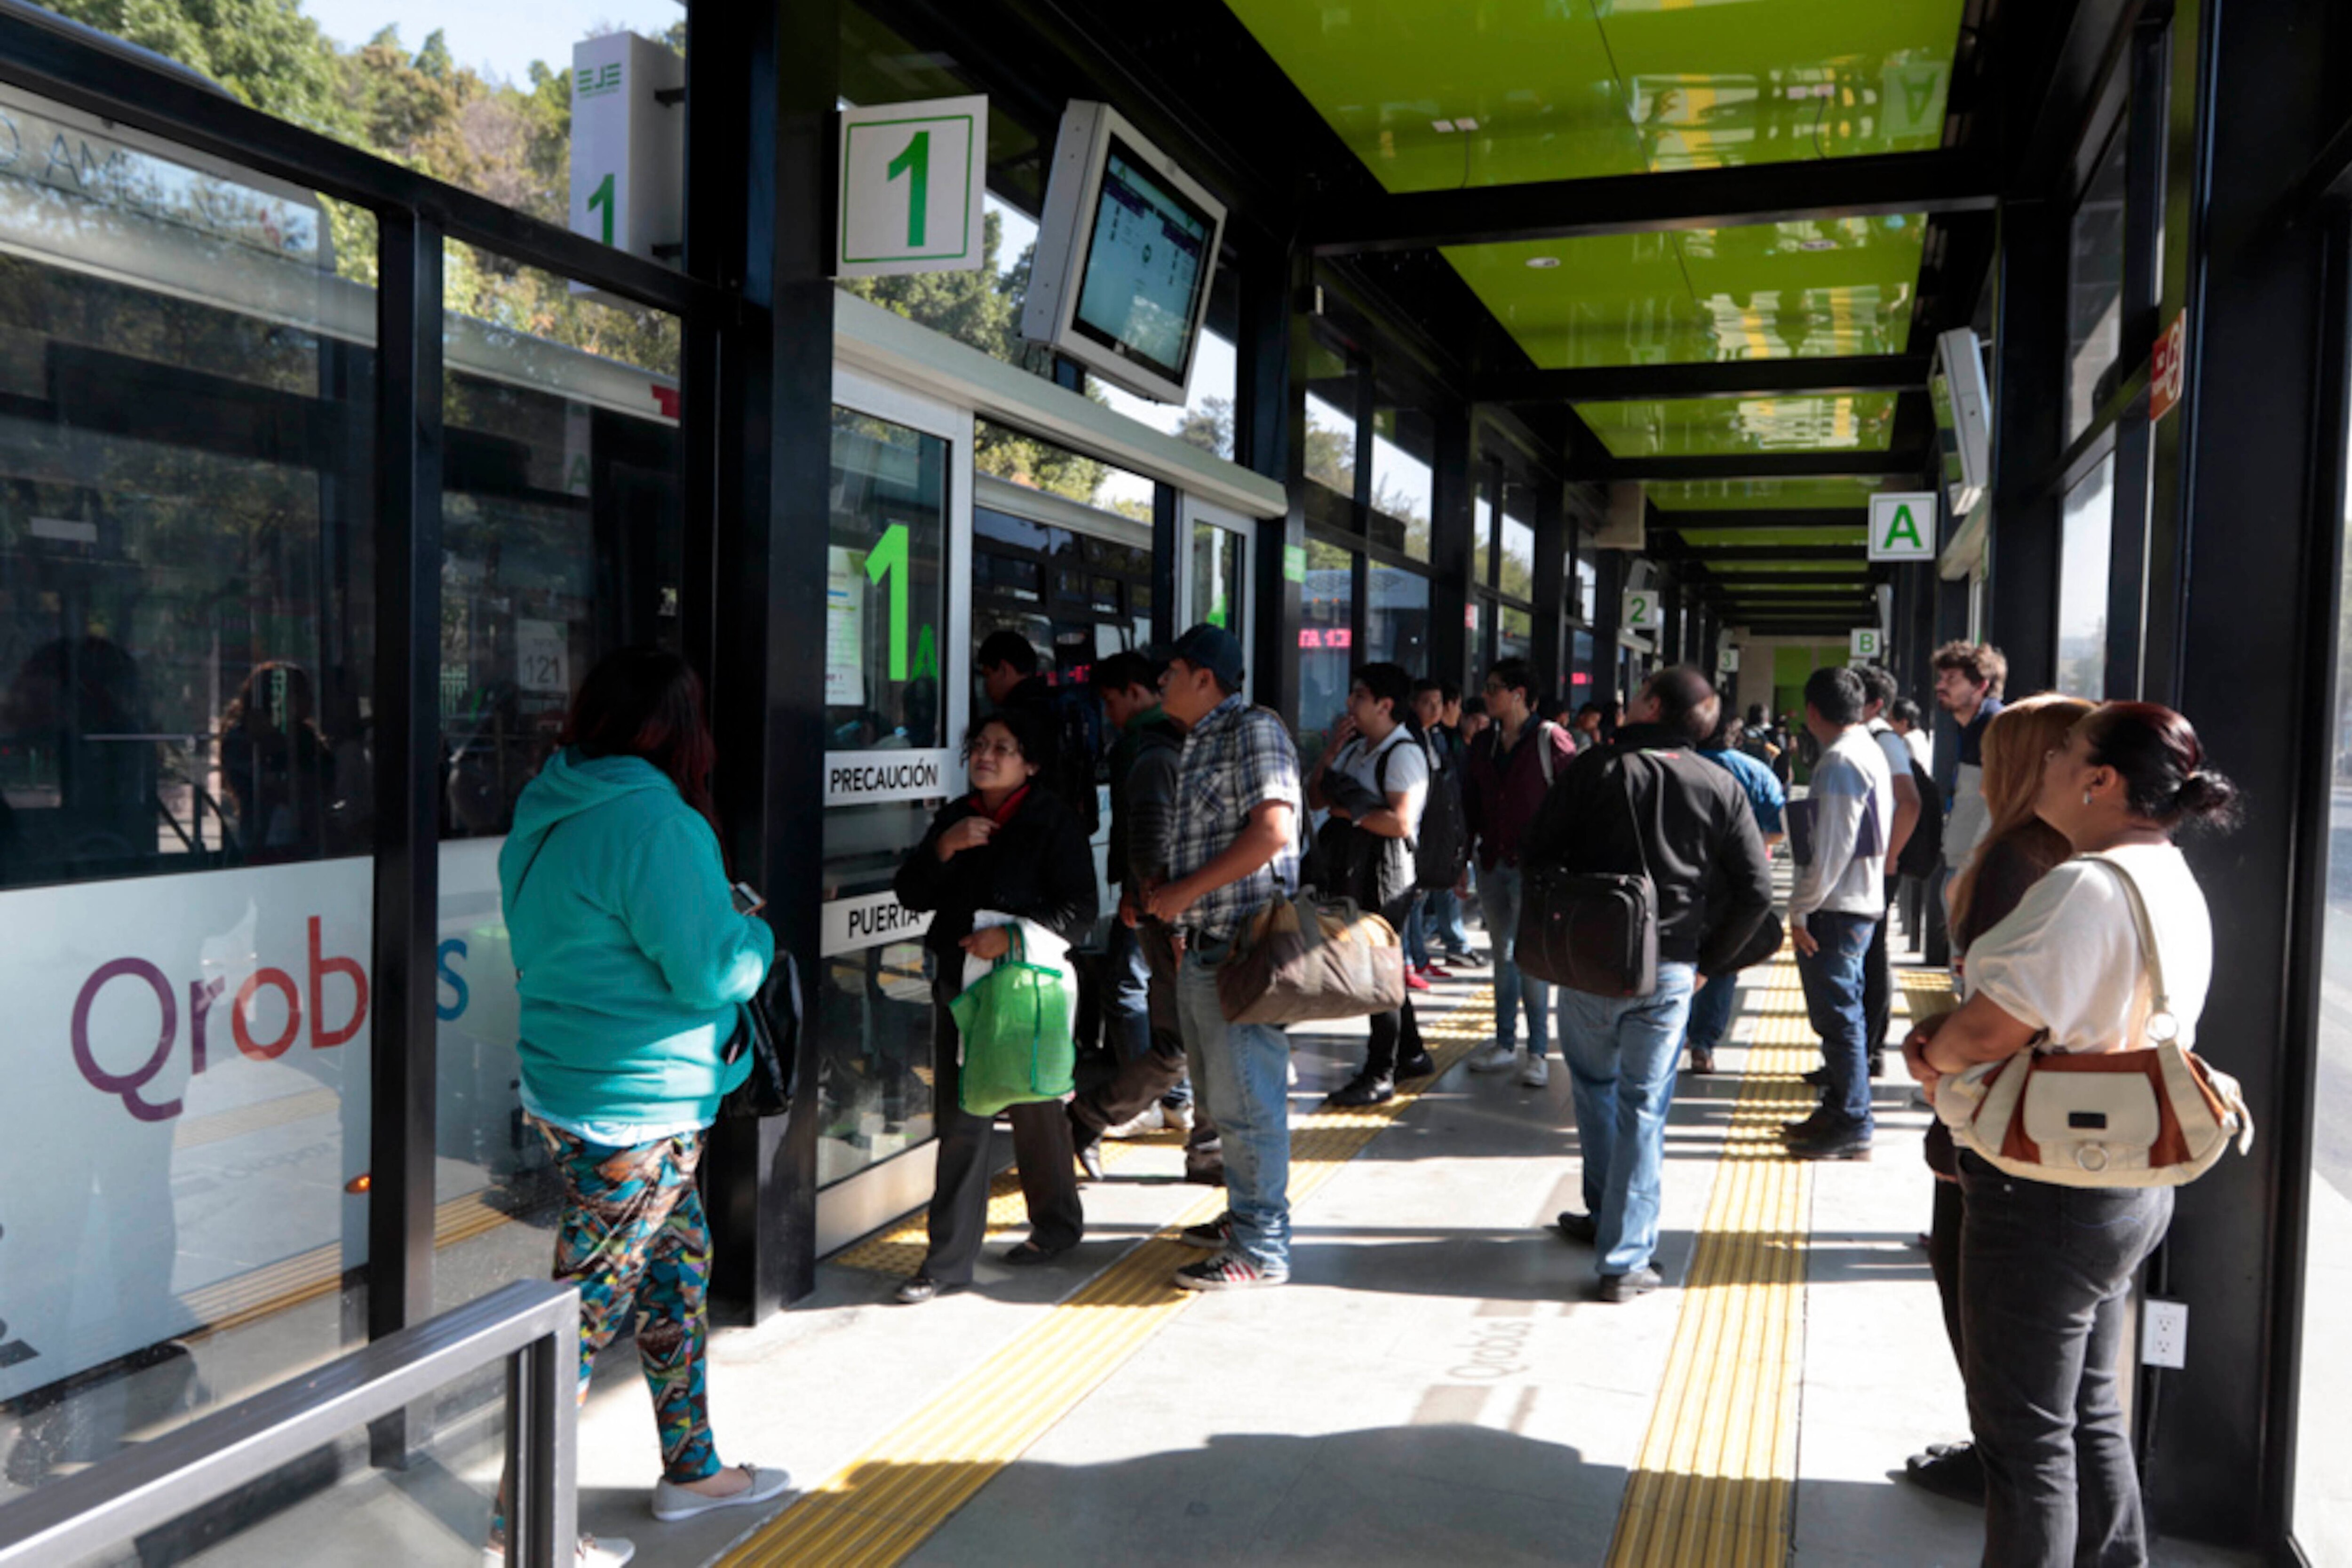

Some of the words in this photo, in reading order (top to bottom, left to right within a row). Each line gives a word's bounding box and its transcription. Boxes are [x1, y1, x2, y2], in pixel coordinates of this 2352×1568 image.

[578, 63, 620, 92] EJE
[887, 131, 929, 247] 1
[587, 174, 615, 247] 1
[1883, 503, 1922, 549] A
[865, 523, 908, 681] 1
[912, 623, 938, 680] A
[1630, 596, 1646, 622] 2
[1723, 653, 1731, 667] 3
[1859, 633, 1874, 653] B
[524, 655, 560, 684] 121
[830, 757, 938, 793] PRECAUCIÓN
[71, 915, 469, 1122] Qrobs
